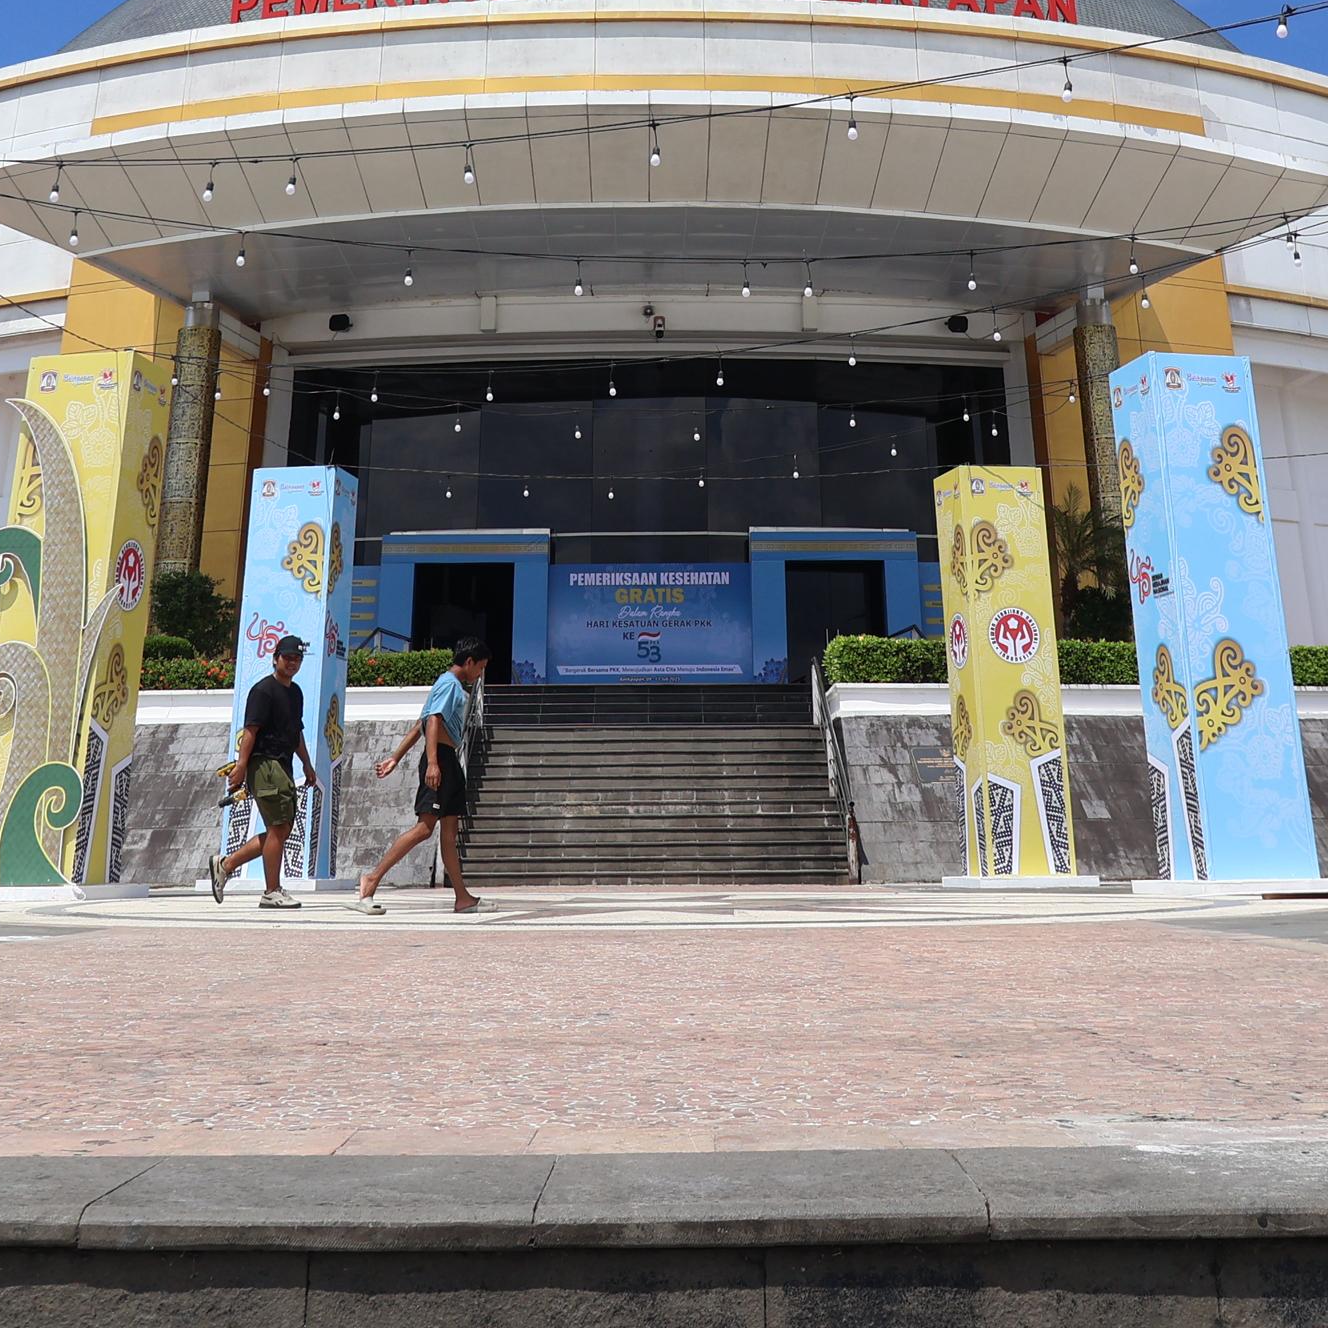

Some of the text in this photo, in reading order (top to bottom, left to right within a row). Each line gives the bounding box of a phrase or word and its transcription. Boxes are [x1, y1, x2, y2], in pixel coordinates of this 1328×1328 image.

[569, 571, 730, 586] PEMERIKSAAN KESEHATAN
[615, 587, 685, 604] GRATIS
[586, 619, 712, 628] HARI KESATUAN GERAK PKK
[622, 631, 635, 640] KE
[637, 641, 662, 663] 53
